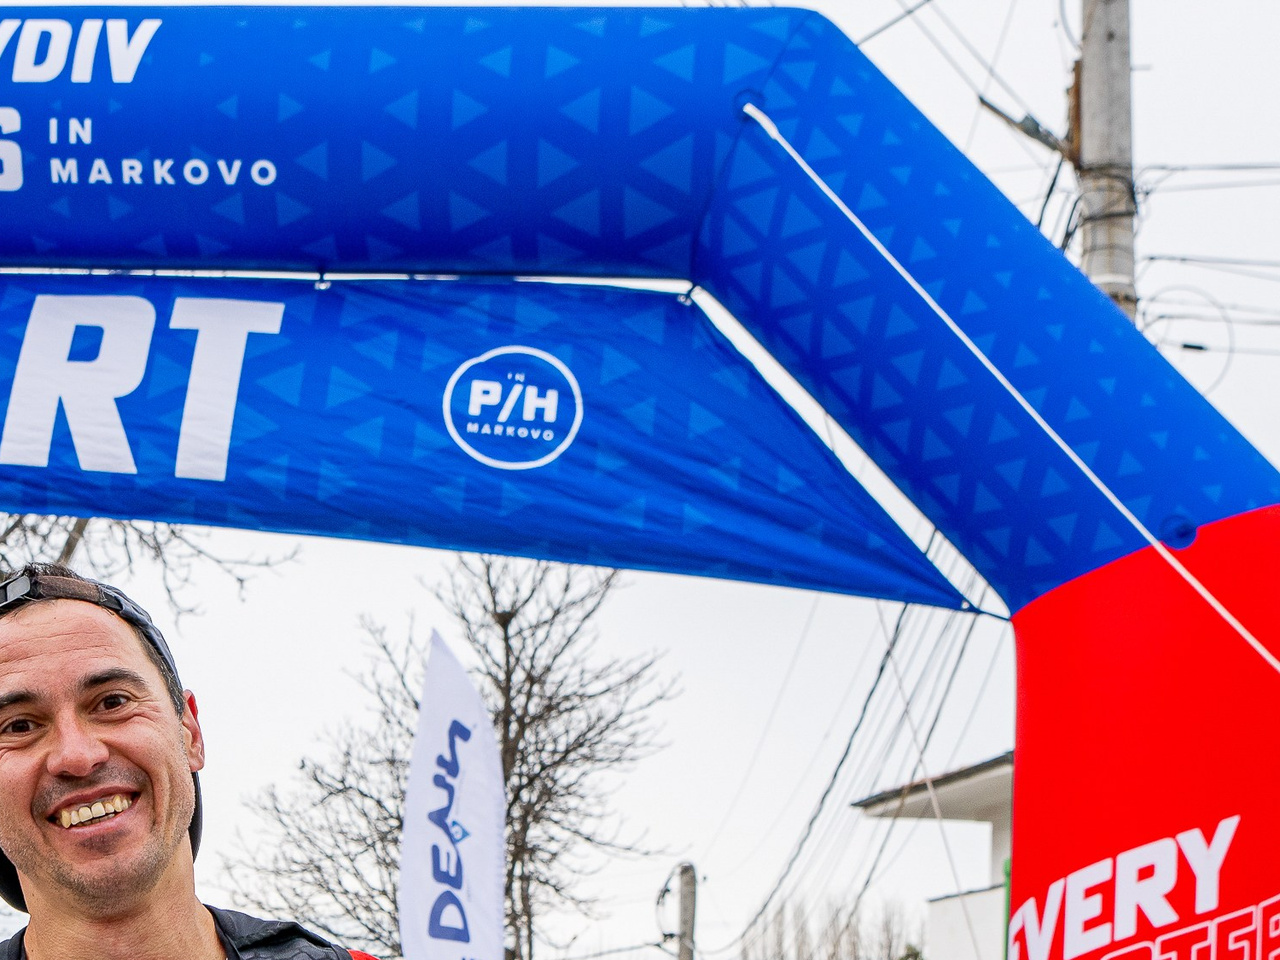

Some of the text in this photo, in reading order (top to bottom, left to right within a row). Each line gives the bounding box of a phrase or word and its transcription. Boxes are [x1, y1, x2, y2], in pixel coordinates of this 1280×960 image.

[48, 117, 93, 145] IN
[49, 158, 278, 186] MARKOVO
[506, 371, 526, 383] IN
[467, 379, 559, 424] P/H
[466, 421, 555, 442] MARKOVO
